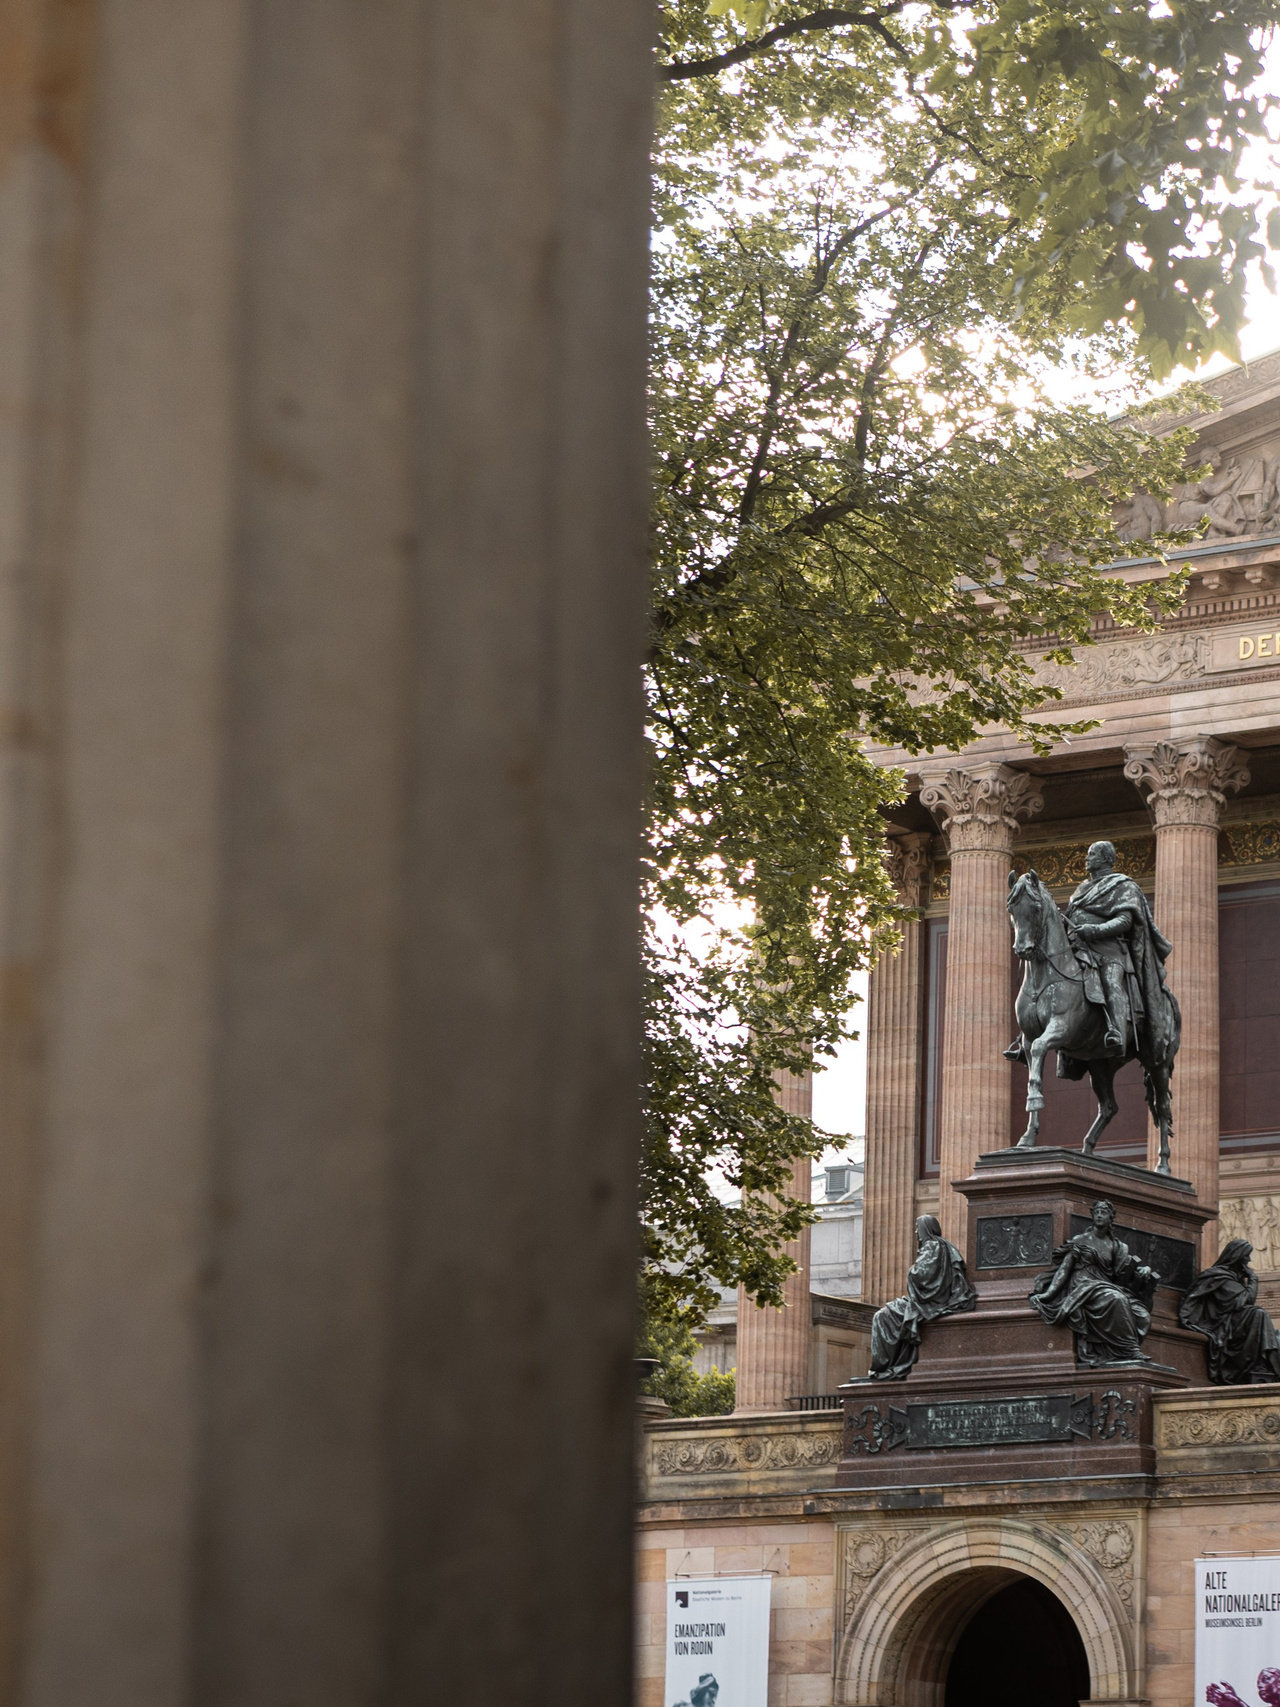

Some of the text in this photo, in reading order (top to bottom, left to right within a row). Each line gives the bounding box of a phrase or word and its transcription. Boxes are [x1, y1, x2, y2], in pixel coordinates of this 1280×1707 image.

[1205, 1571, 1227, 1589] ALTE
[675, 1623, 725, 1637] EMANZIPATION
[674, 1641, 713, 1655] VON RODIN
